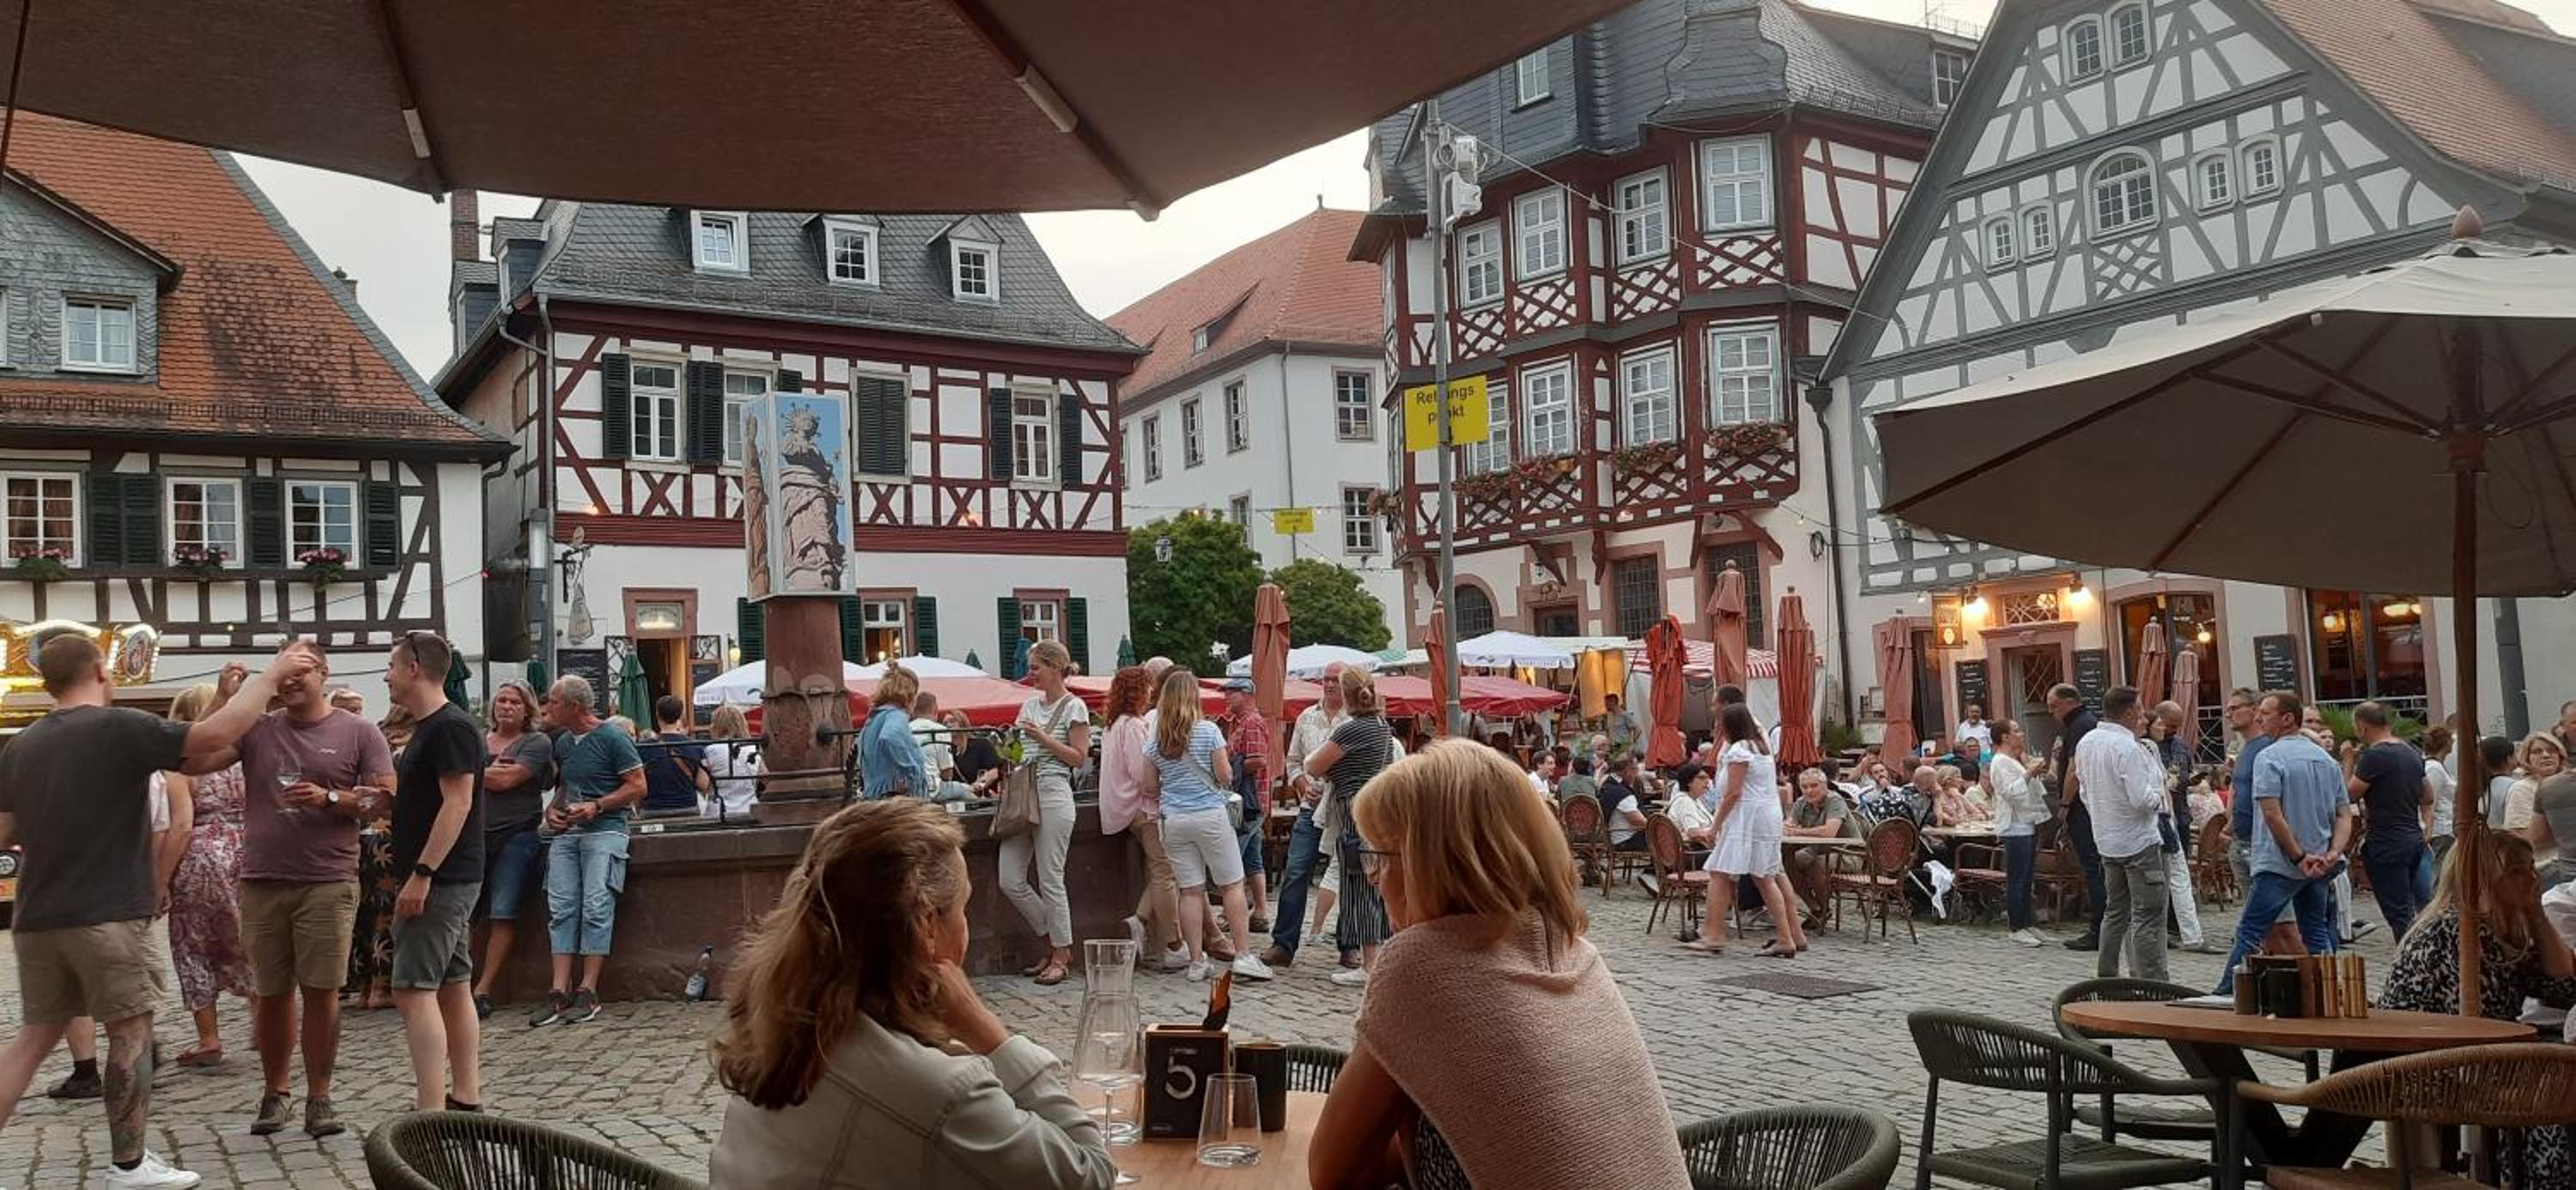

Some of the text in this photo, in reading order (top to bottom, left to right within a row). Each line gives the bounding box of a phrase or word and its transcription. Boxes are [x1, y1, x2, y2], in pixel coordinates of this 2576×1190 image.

[1416, 386, 1474, 405] Retngs
[1428, 404, 1464, 427] pkt
[1164, 1047, 1197, 1100] 5
